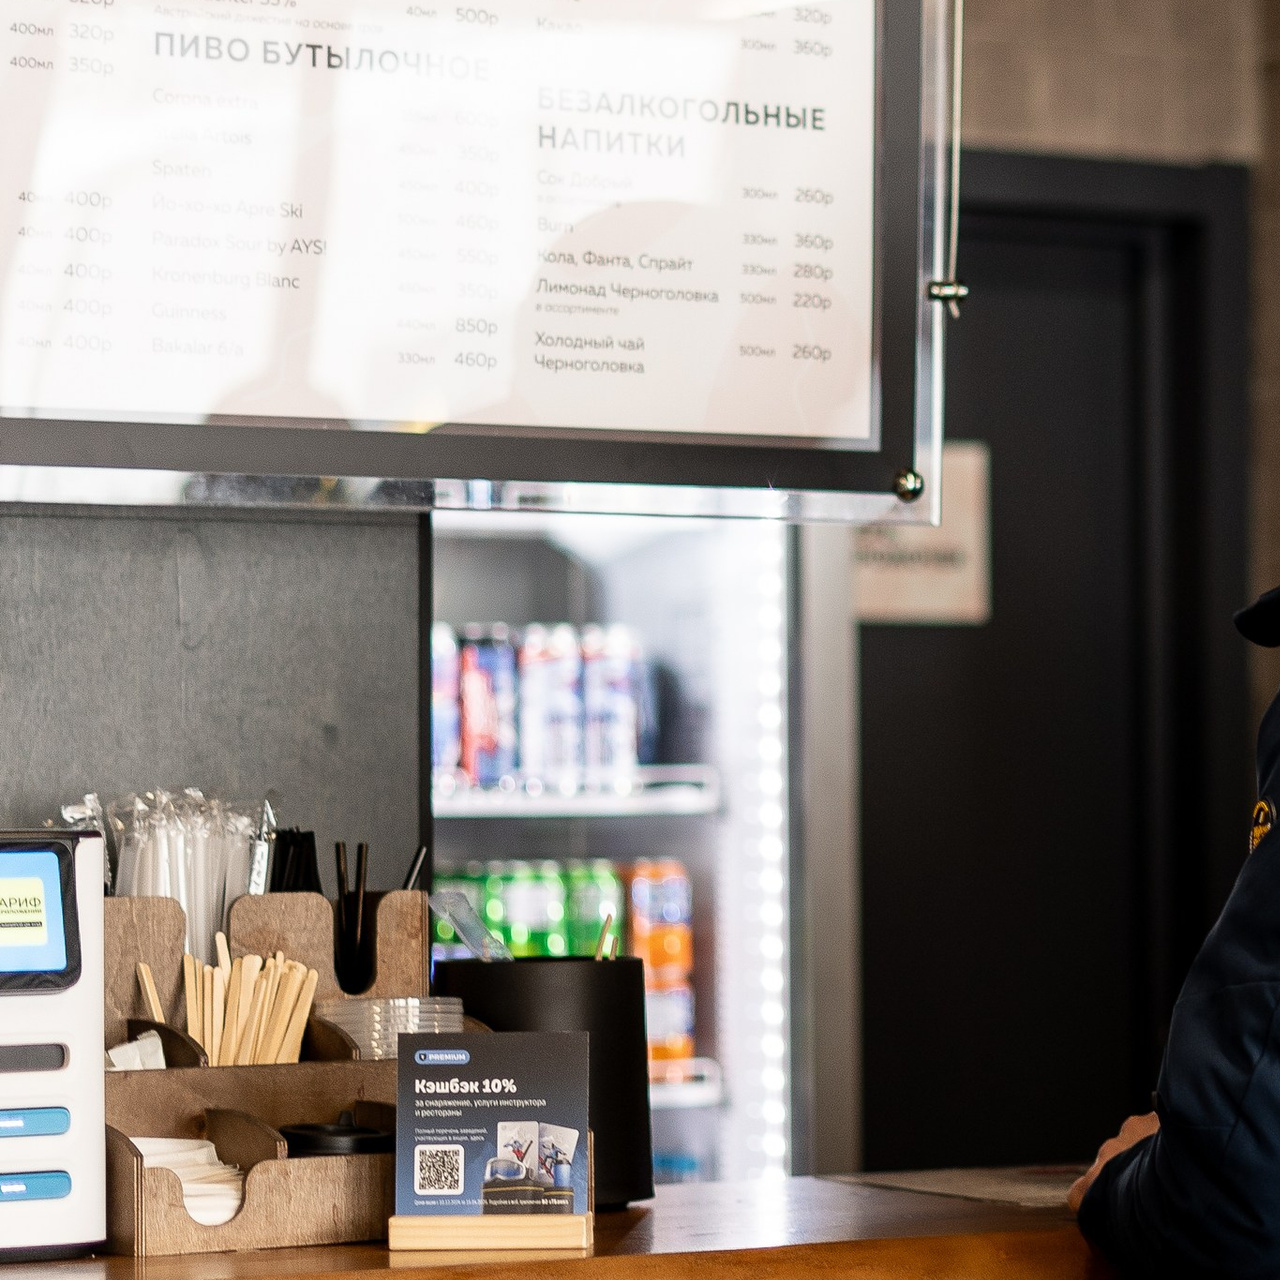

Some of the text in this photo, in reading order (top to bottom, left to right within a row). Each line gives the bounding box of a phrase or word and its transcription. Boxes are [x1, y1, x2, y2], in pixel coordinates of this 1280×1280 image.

[455, 7, 500, 28] 500р
[154, 32, 490, 82] ПИВО БУТЫЛОЧНОЕ
[538, 85, 826, 131] БЕЗАЛКОГОЛЬНЫЕ
[538, 125, 686, 159] НАПИТКИ
[279, 202, 303, 220] Ski
[638, 253, 695, 273] Спрайт
[536, 278, 607, 298] Лимонад
[611, 283, 720, 305] Черноголовка
[455, 317, 498, 338] 850р
[534, 331, 614, 351] Холодный
[618, 336, 646, 352] чай
[534, 354, 646, 375] Черноголовка
[428, 1053, 466, 1061] PREMIUM
[415, 1078, 517, 1093] Кэшбэк 10%
